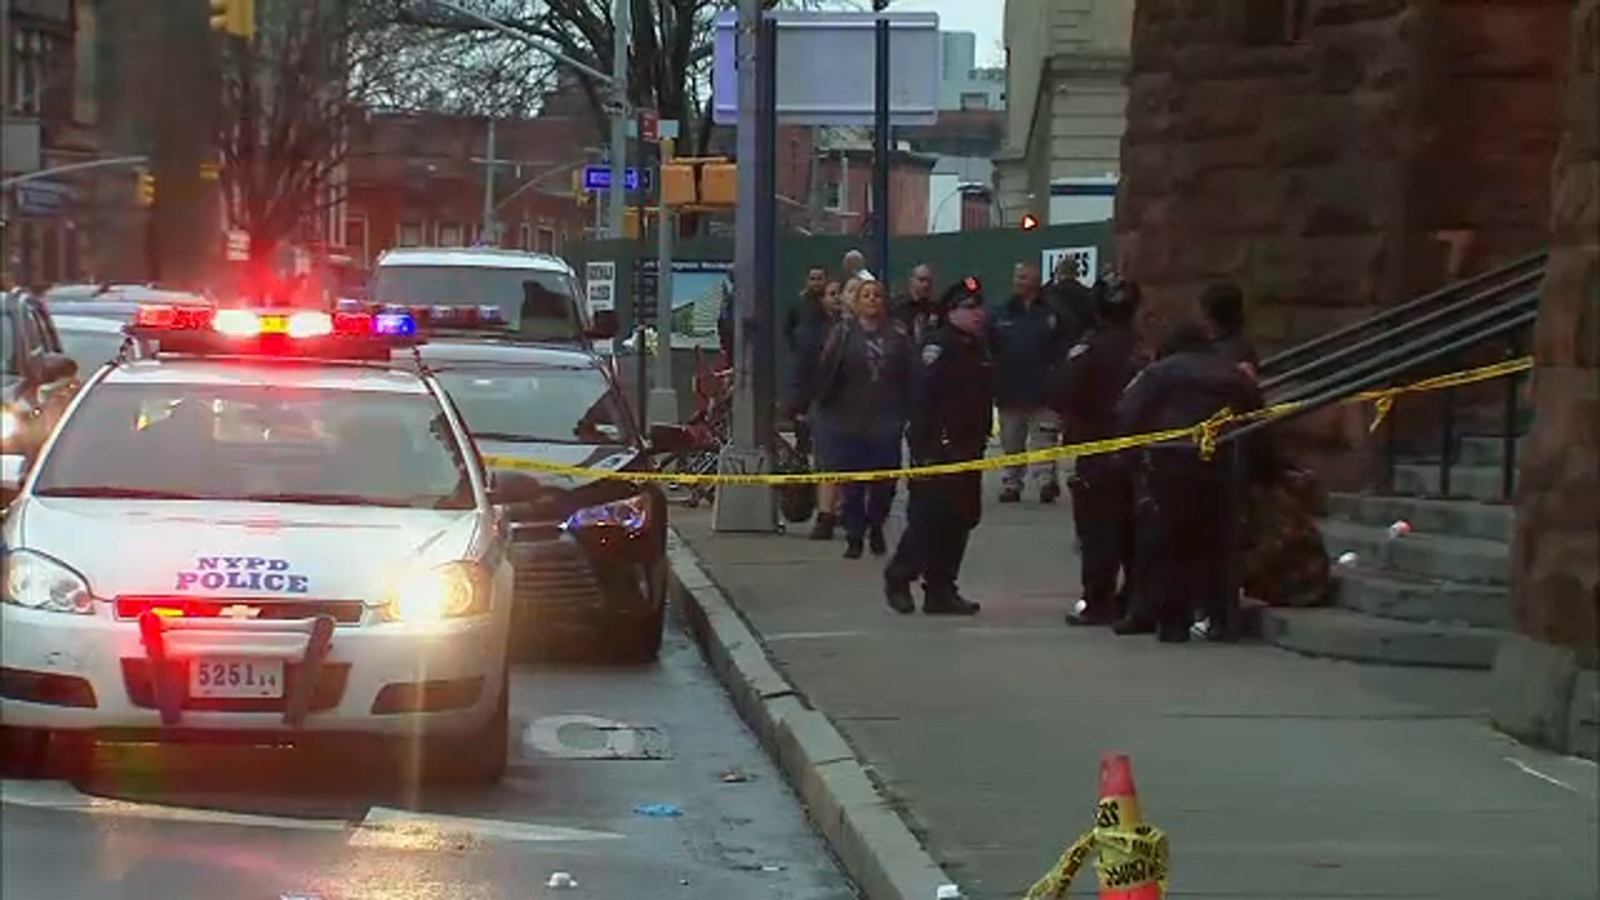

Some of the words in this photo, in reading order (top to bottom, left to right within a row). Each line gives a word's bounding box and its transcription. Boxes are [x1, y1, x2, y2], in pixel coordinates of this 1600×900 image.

[1049, 252, 1090, 279] LES
[197, 556, 290, 571] NYPD
[175, 572, 308, 593] POLICE
[199, 662, 255, 686] 5251
